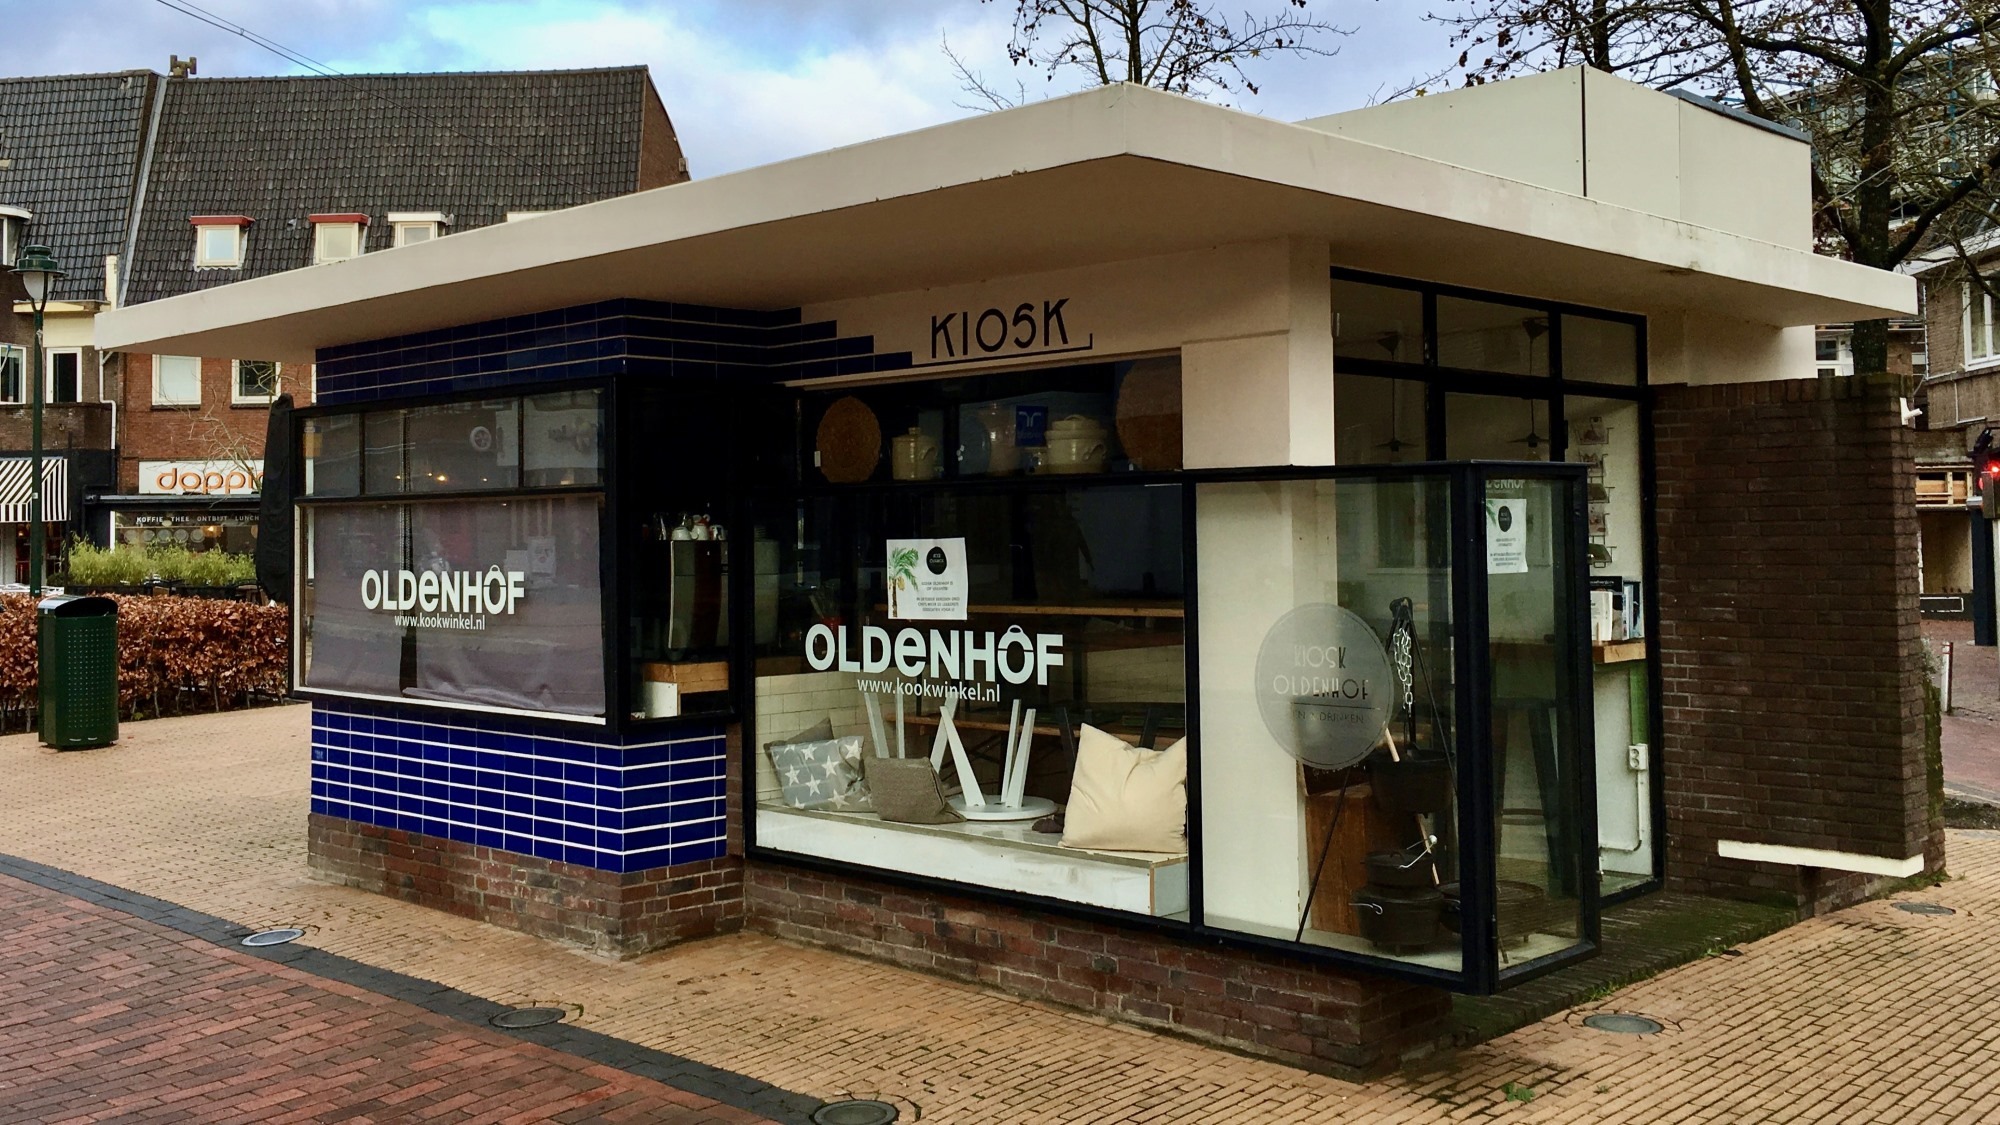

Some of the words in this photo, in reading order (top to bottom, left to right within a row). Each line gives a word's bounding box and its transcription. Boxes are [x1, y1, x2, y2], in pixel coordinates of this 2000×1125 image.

[931, 298, 1071, 359] KIOSK
[156, 467, 264, 494] doppi
[394, 613, 486, 631] www.kookwinkel.nl
[1294, 645, 1347, 669] KIOSK
[857, 676, 1000, 703] www.kookwinkel.nl
[1273, 675, 1369, 700] OLDENHOF
